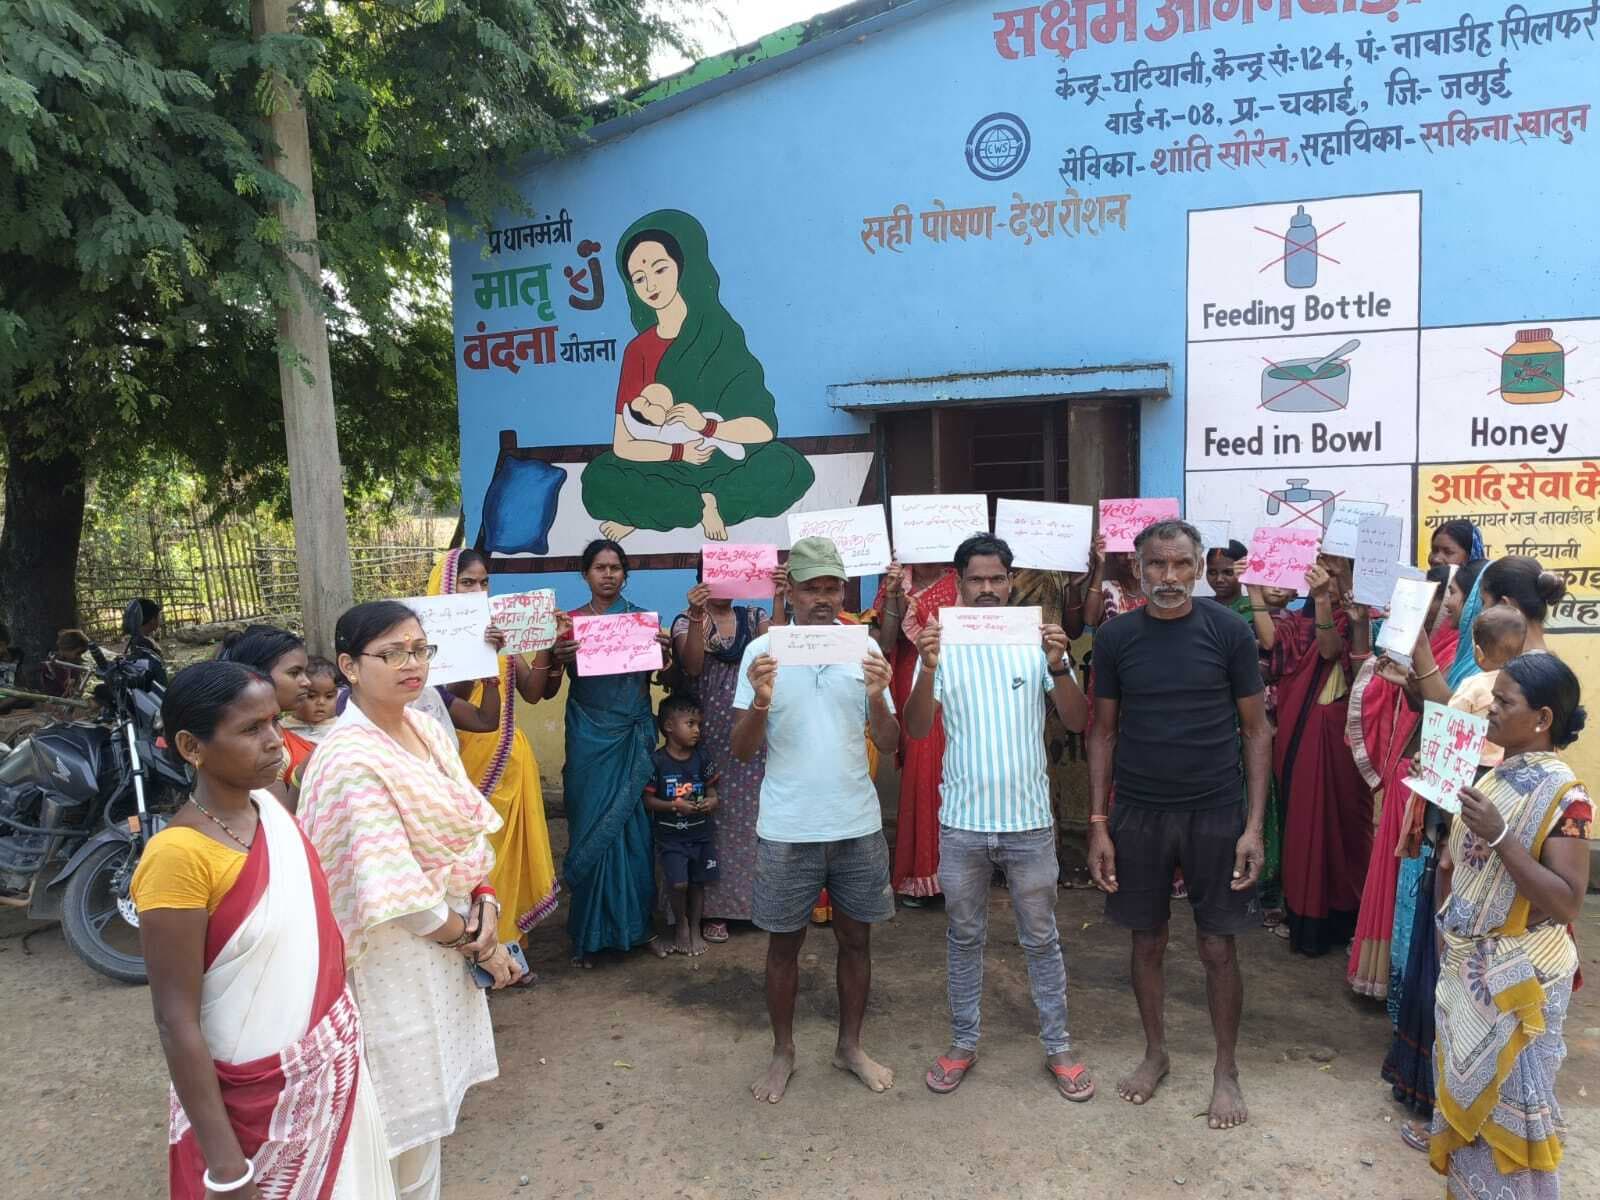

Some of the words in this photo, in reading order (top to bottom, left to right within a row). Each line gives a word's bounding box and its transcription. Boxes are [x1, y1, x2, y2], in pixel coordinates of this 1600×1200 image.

[1438, 57, 1513, 106] जमुई
[987, 143, 1008, 155] CWS
[1420, 109, 1513, 154] सकिना
[488, 207, 574, 255] प्रधानमंत्री
[861, 203, 913, 255] सही
[472, 263, 557, 322] मातृ
[1203, 300, 1295, 331] Feeding
[1305, 291, 1391, 322] Bottle
[463, 321, 559, 374] वंदना
[560, 333, 617, 364] योजना
[1205, 425, 1263, 456] Feed
[1273, 425, 1300, 454] in
[1312, 421, 1382, 453] Bowl
[1471, 417, 1568, 454] Honey
[1428, 464, 1510, 510] आदि
[1507, 463, 1573, 500] सेवा
